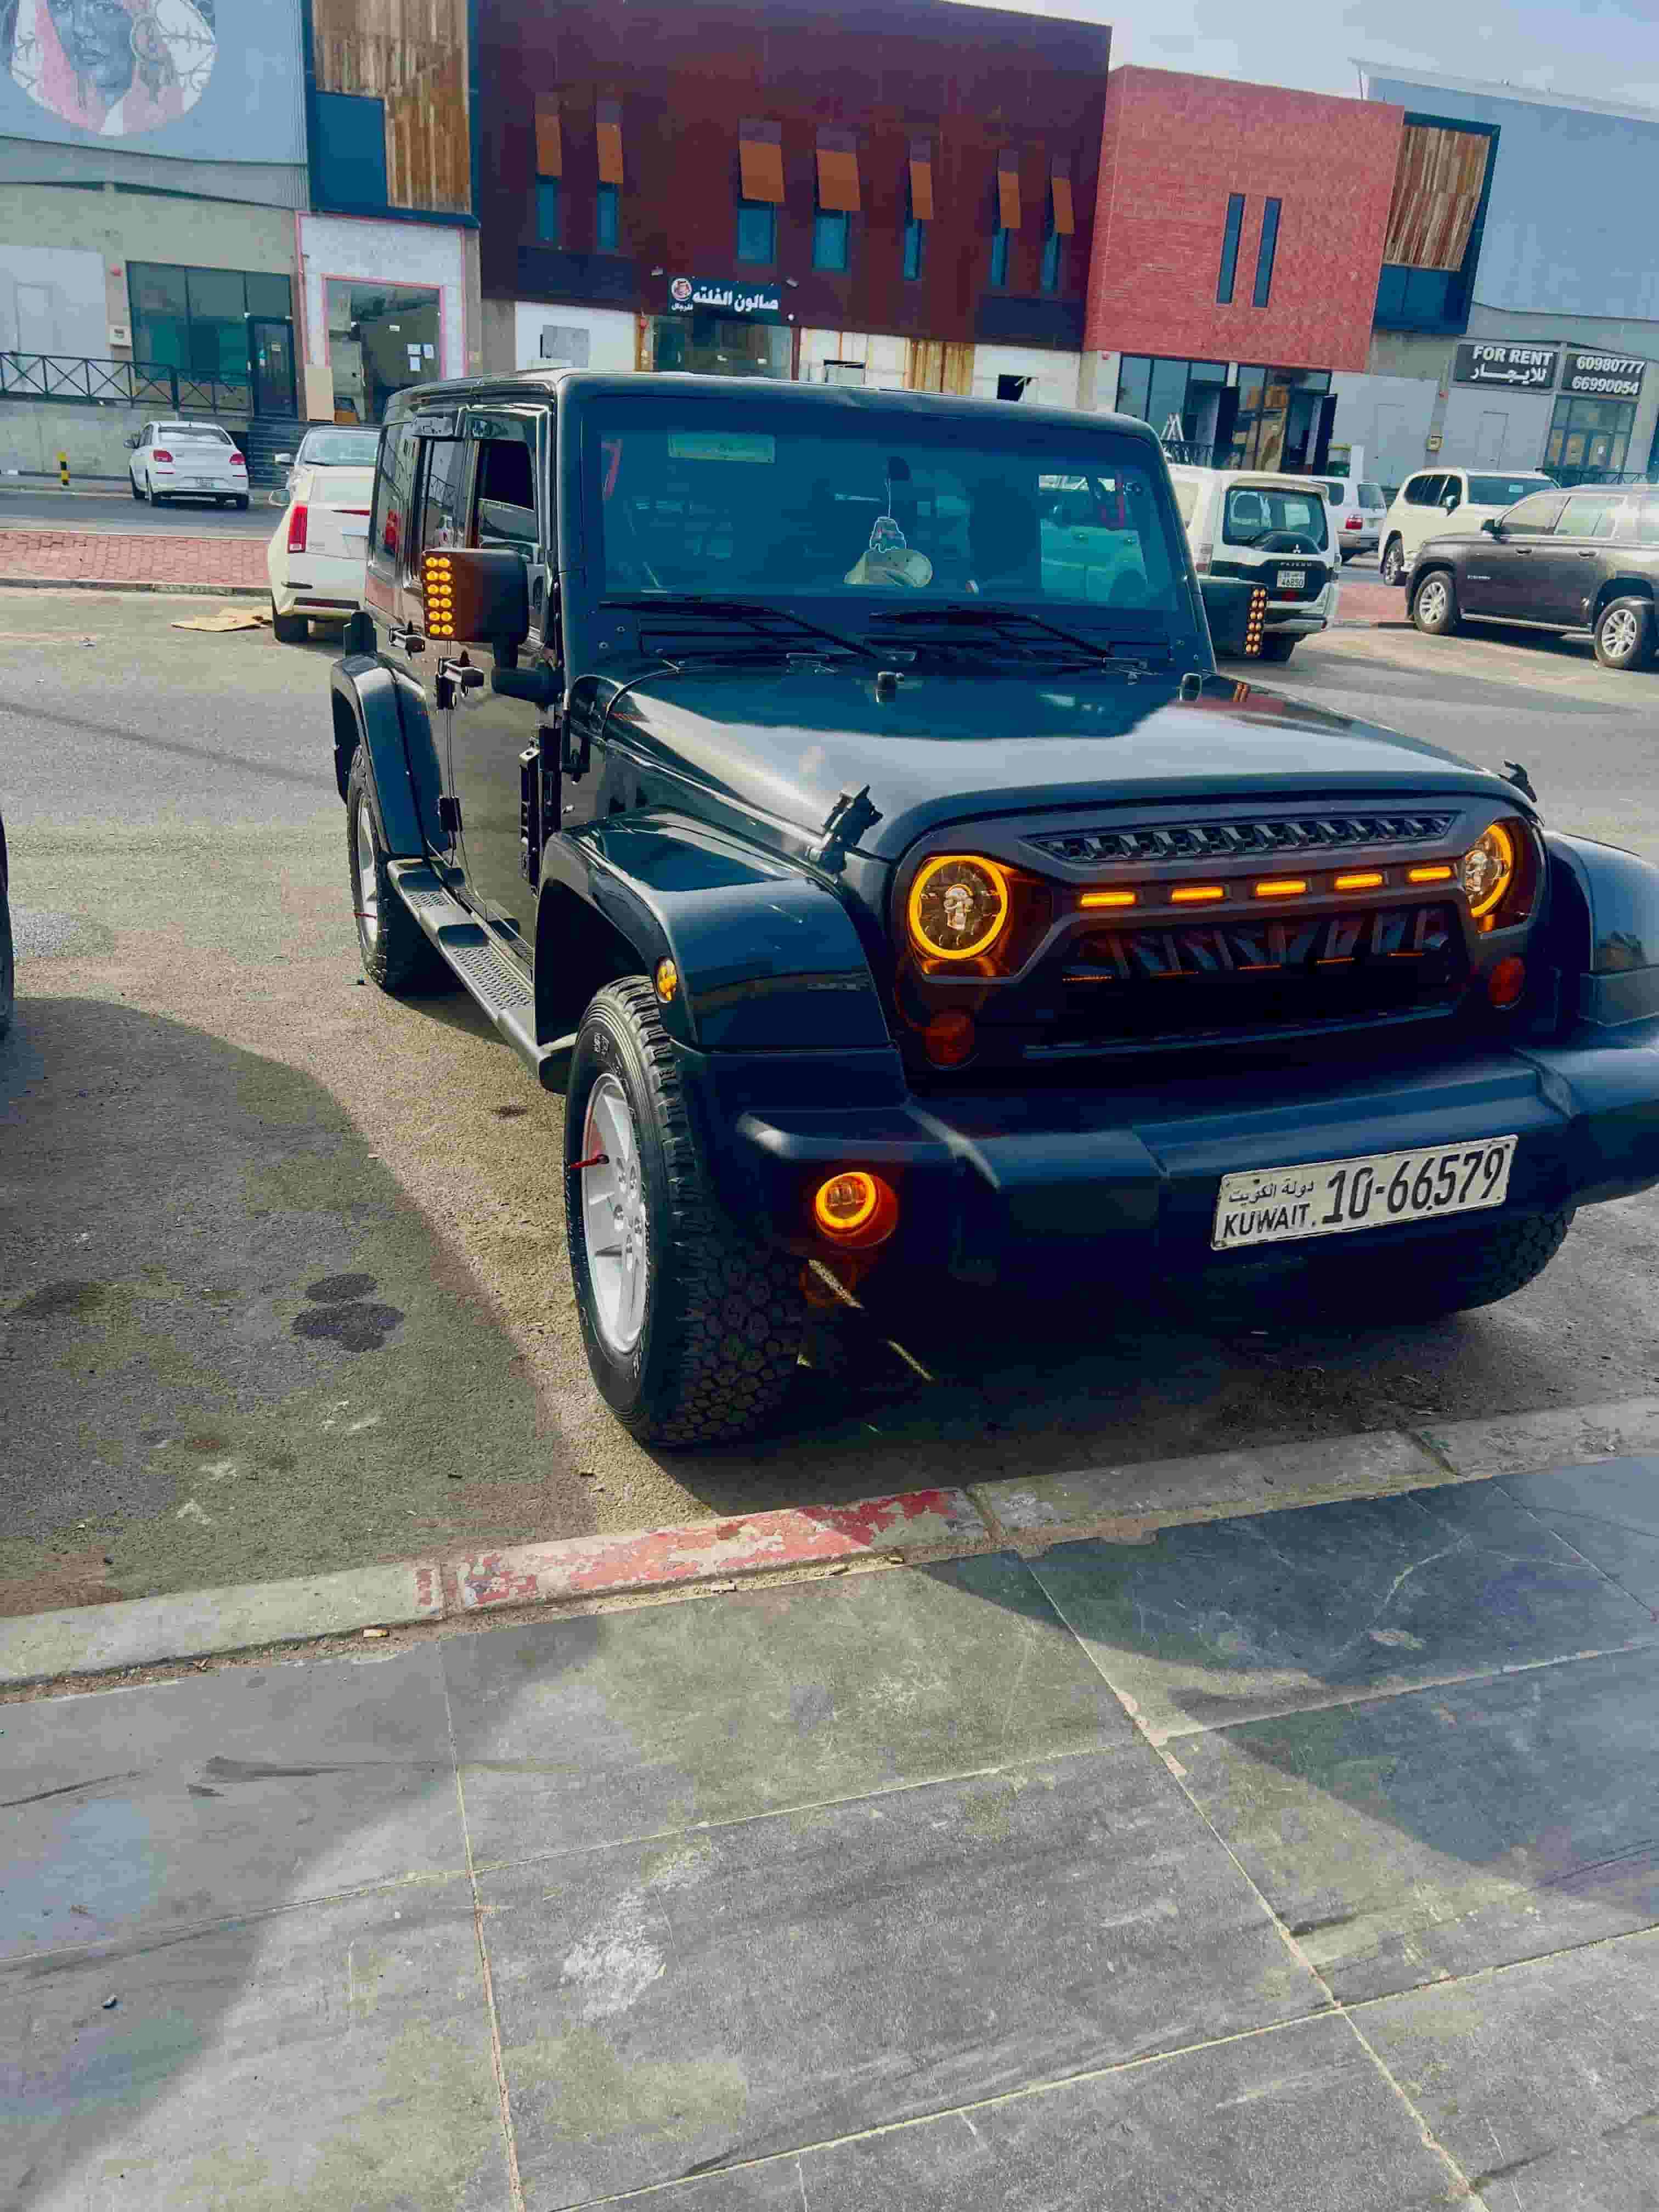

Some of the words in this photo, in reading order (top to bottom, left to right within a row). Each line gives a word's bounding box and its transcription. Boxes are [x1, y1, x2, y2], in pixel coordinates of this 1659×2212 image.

[733, 294, 779, 312] صالون
[1472, 345, 1506, 363] FOR
[1509, 348, 1554, 366] RENT
[1576, 356, 1645, 374] 60980777
[1571, 375, 1639, 395] 66990054
[1228, 1183, 1277, 1206] الكويت
[1282, 1178, 1314, 1198] دولة
[1322, 1147, 1505, 1224] 10-66579
